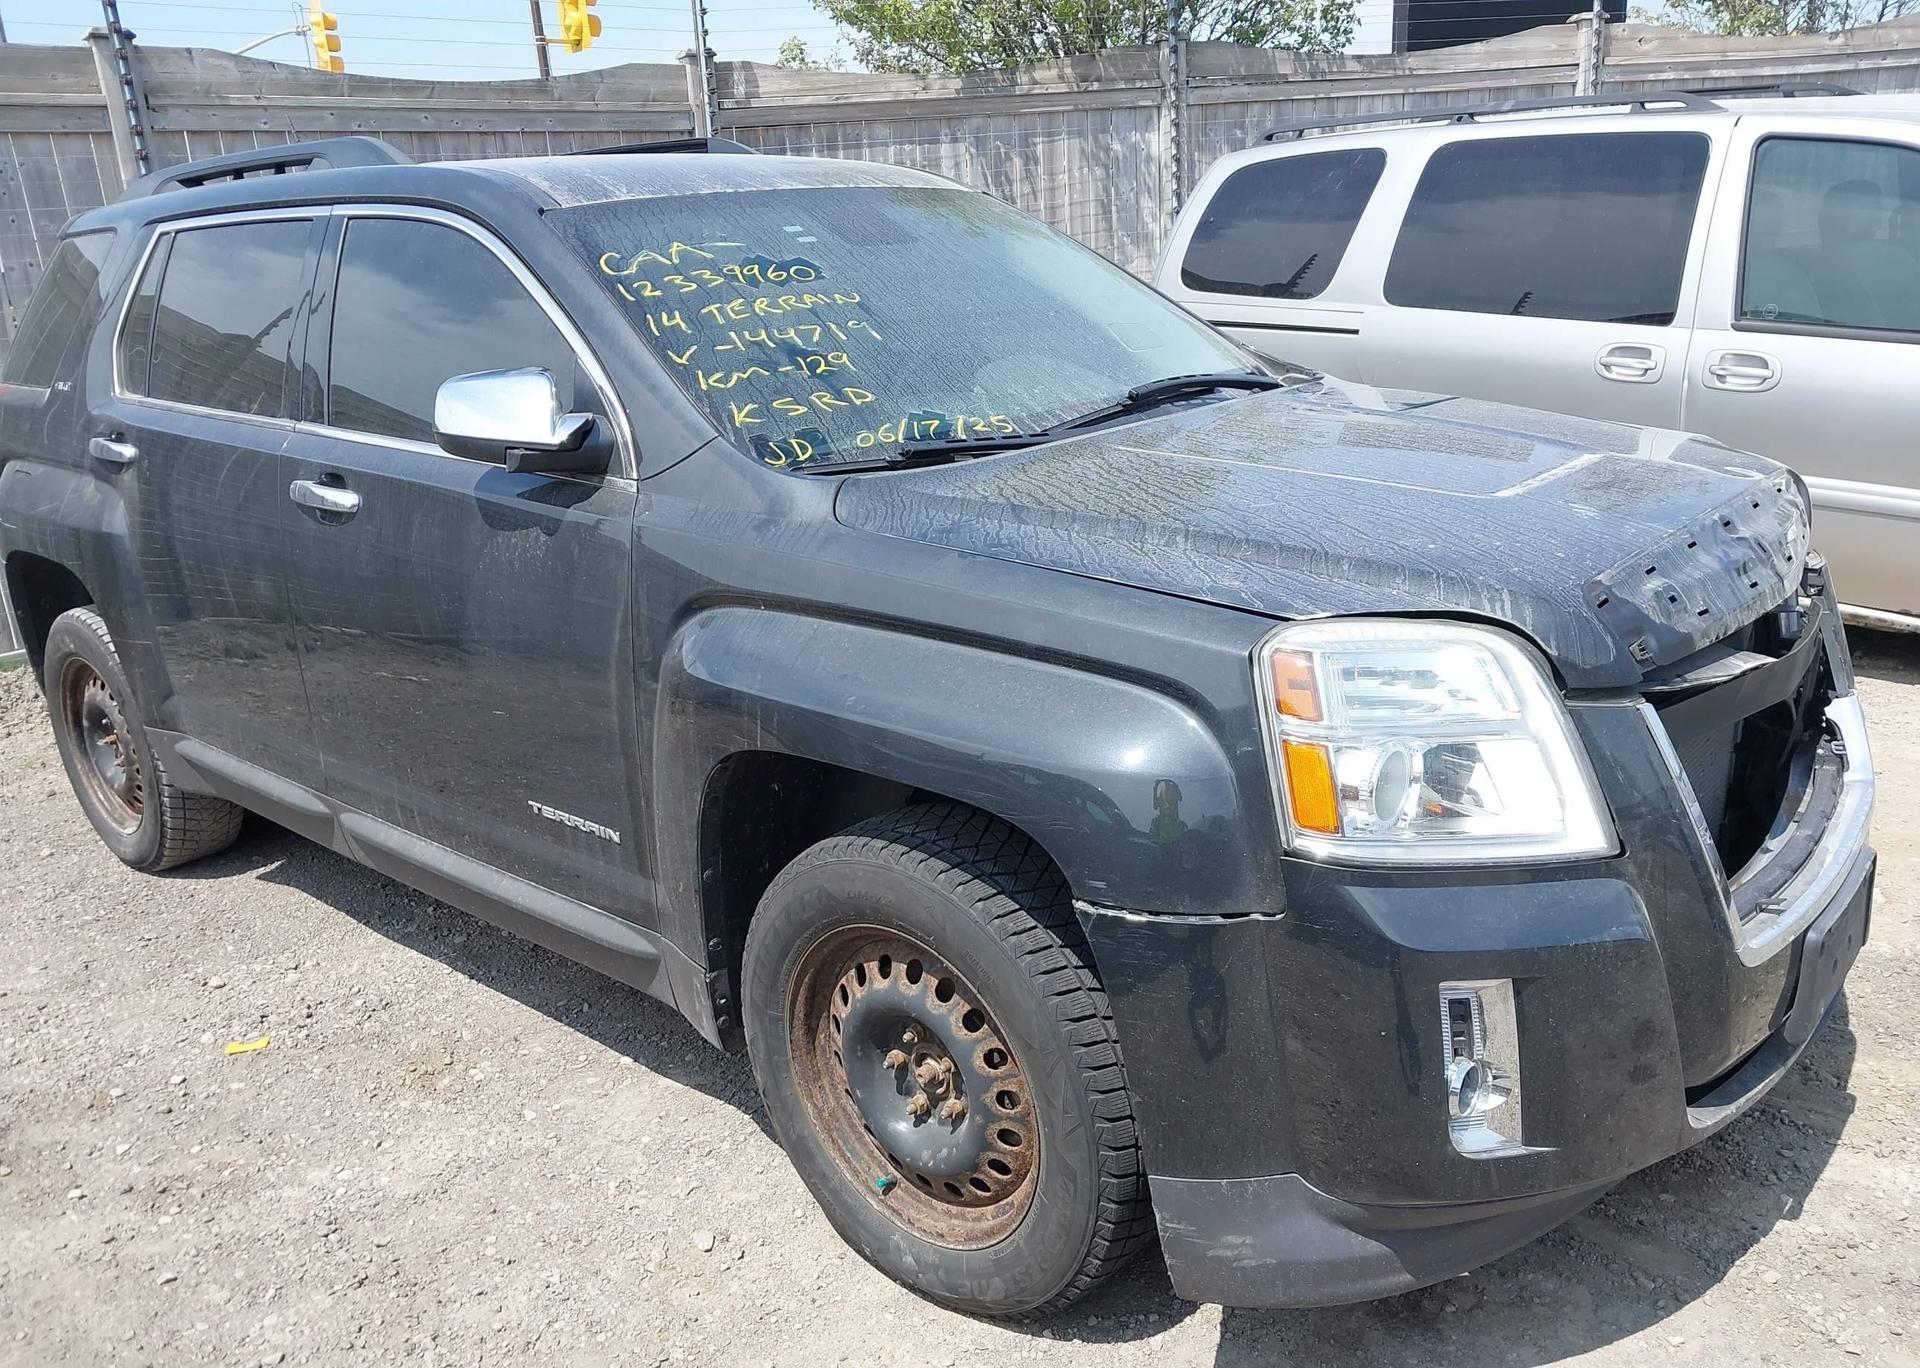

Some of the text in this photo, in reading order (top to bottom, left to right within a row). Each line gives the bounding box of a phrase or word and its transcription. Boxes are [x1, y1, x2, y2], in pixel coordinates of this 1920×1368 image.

[616, 263, 816, 301] 12339960
[646, 292, 861, 337] 14 TERRAIN
[764, 415, 1014, 465] JD 06/17/25
[527, 799, 621, 843] TERRAIN
